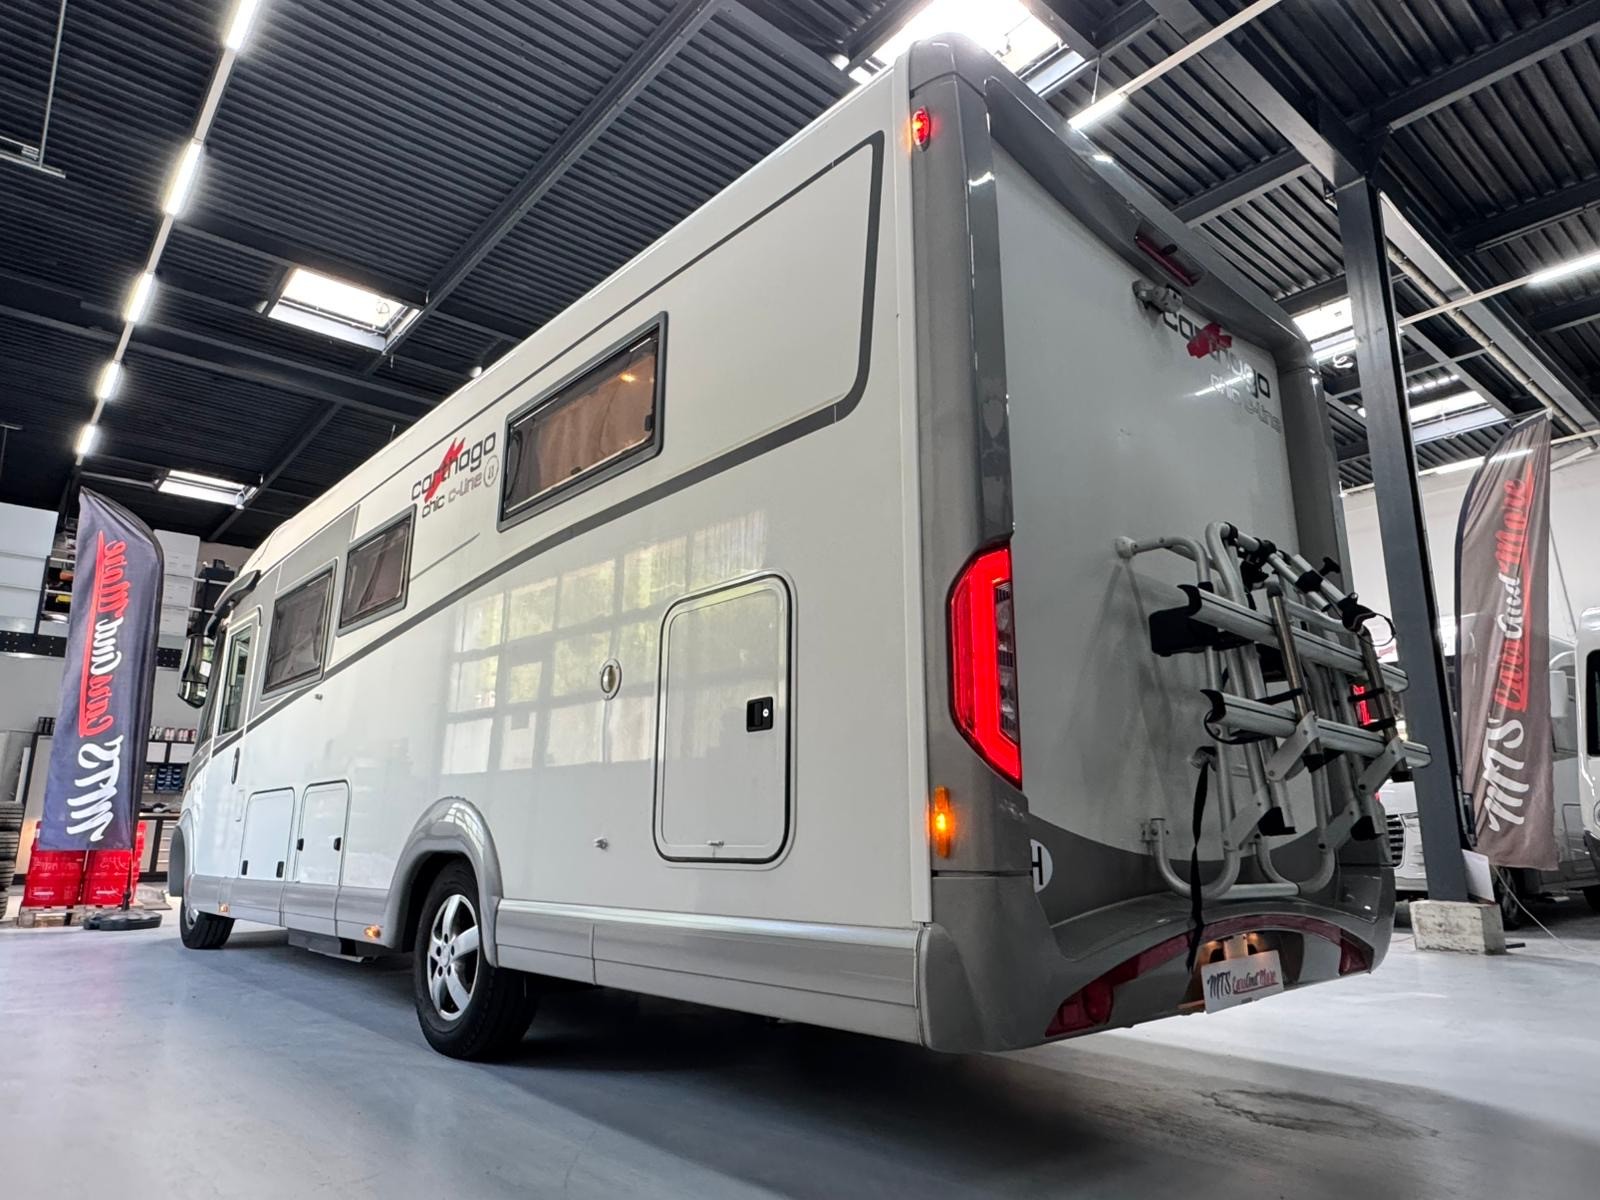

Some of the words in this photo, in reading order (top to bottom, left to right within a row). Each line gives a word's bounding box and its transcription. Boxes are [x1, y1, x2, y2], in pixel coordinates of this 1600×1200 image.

[411, 432, 497, 502] carthago
[421, 494, 446, 519] chic
[1482, 717, 1530, 832] MTS
[1206, 970, 1232, 999] MTS
